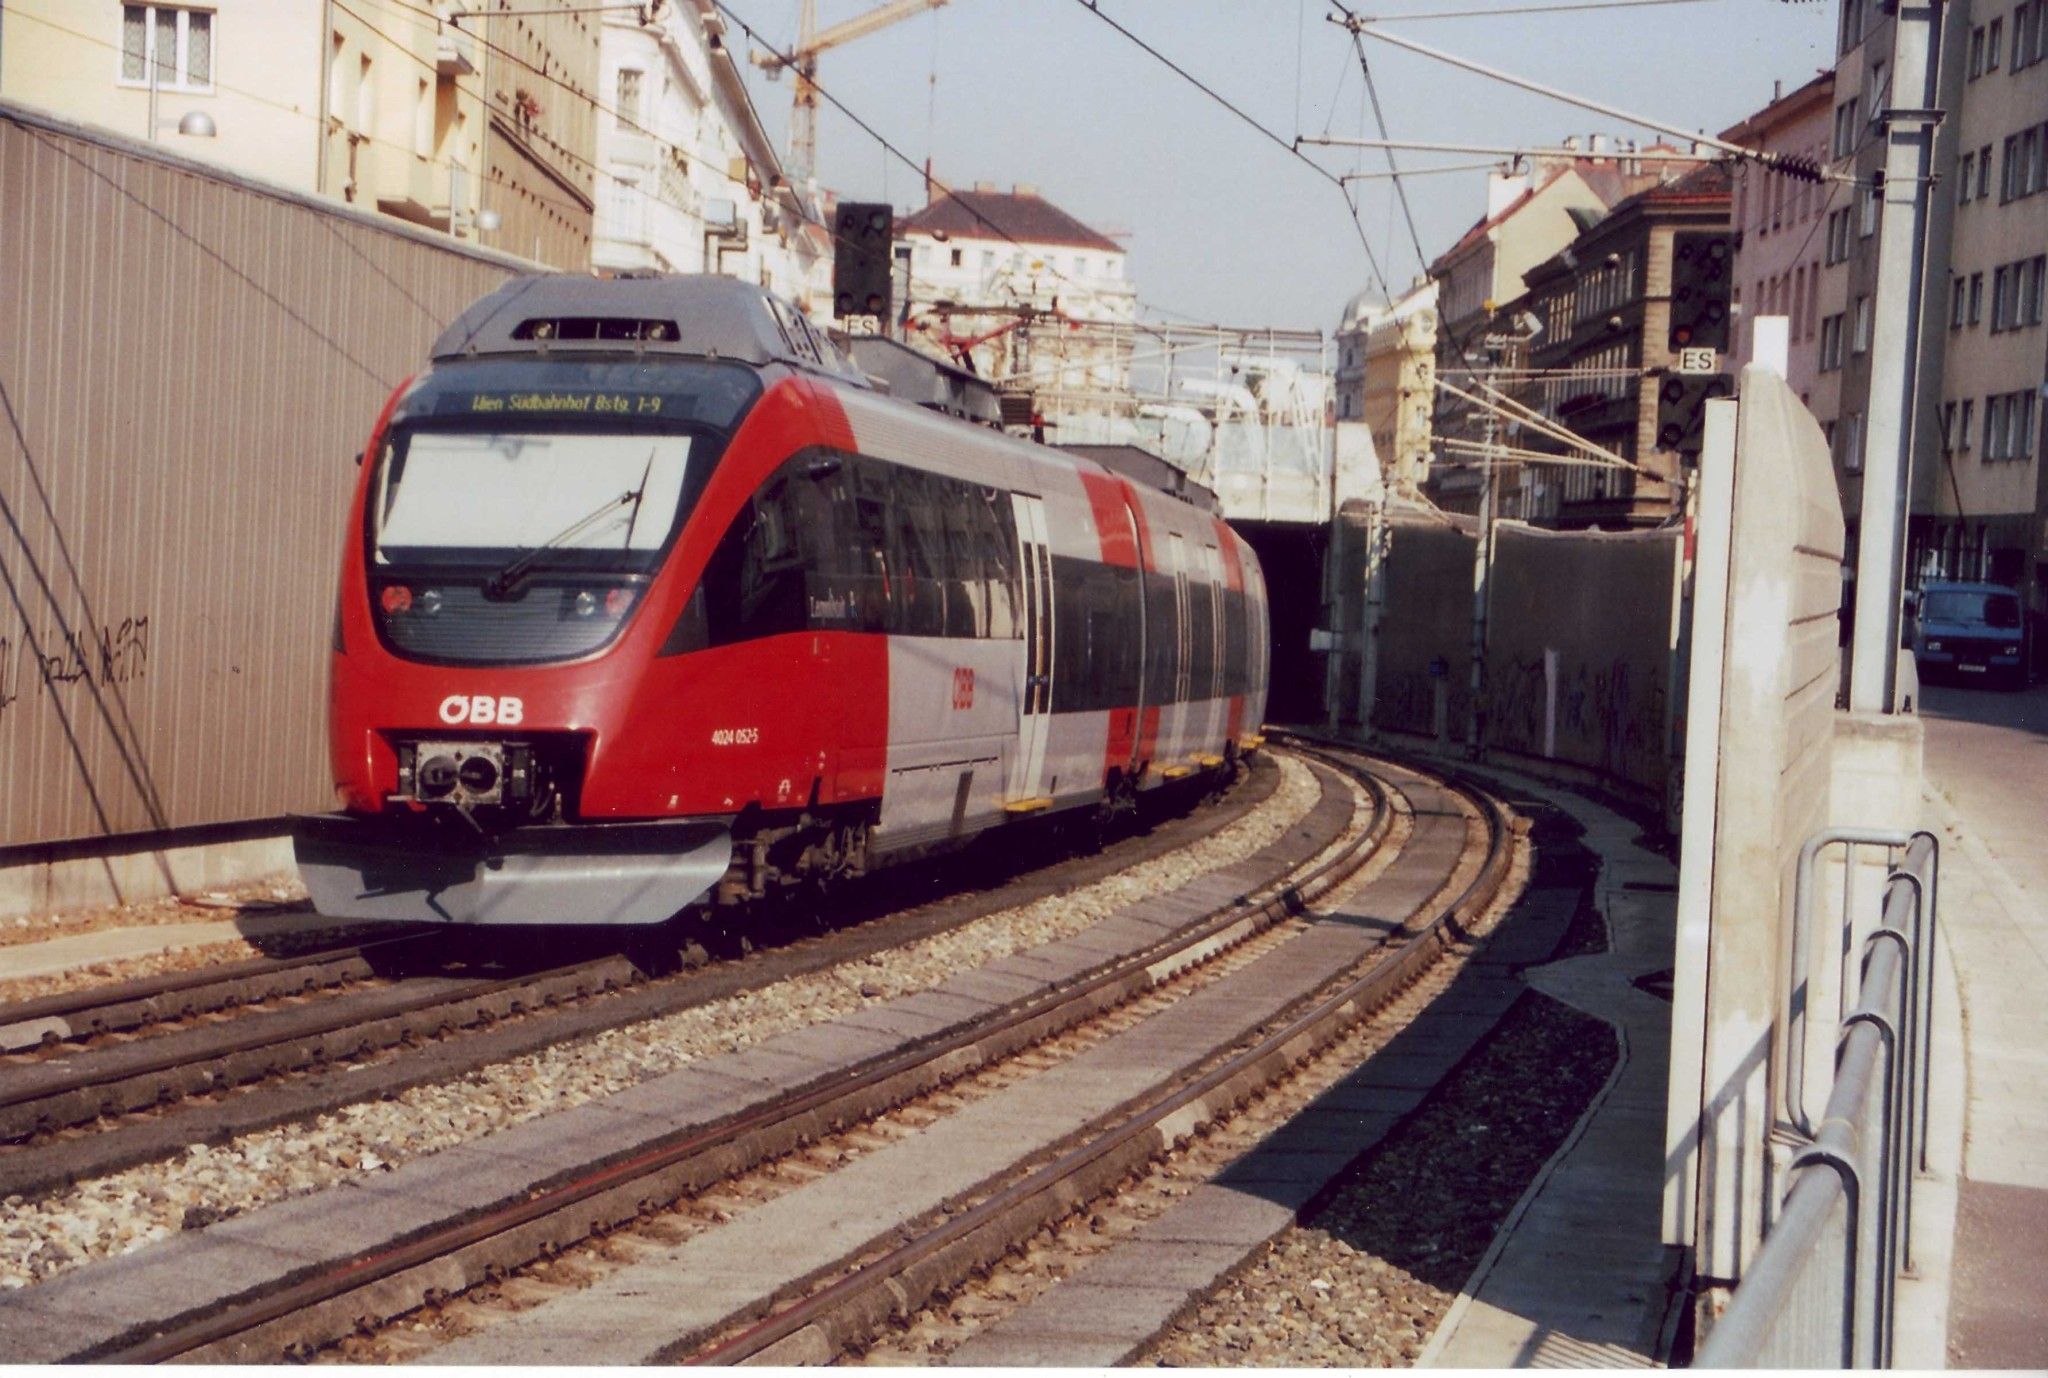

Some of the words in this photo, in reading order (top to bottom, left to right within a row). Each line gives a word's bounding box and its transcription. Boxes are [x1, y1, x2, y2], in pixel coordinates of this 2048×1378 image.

[1683, 352, 1712, 370] ES
[638, 396, 661, 413] 1-9
[711, 729, 734, 746] 4024
